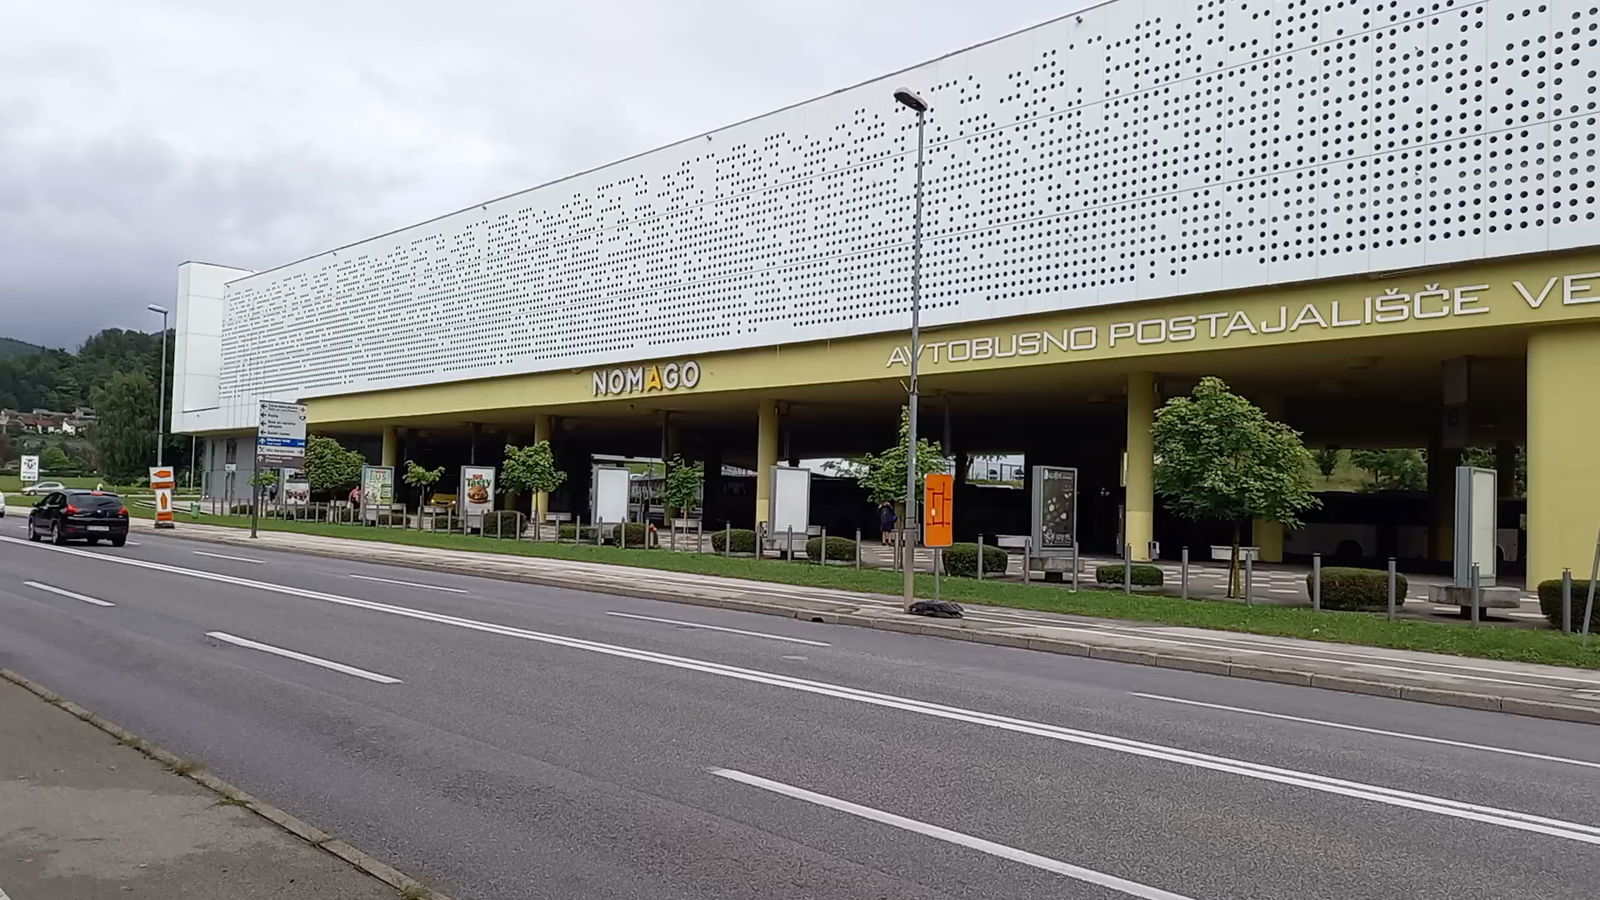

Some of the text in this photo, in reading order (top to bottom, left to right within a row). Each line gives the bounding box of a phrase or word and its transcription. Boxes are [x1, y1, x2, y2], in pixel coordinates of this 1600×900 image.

[886, 326, 1097, 367] AVTOBUSNO
[1109, 282, 1490, 347] POSTAJALIŠČE
[592, 361, 700, 397] NOMAGO
[466, 478, 491, 488] Tasty
